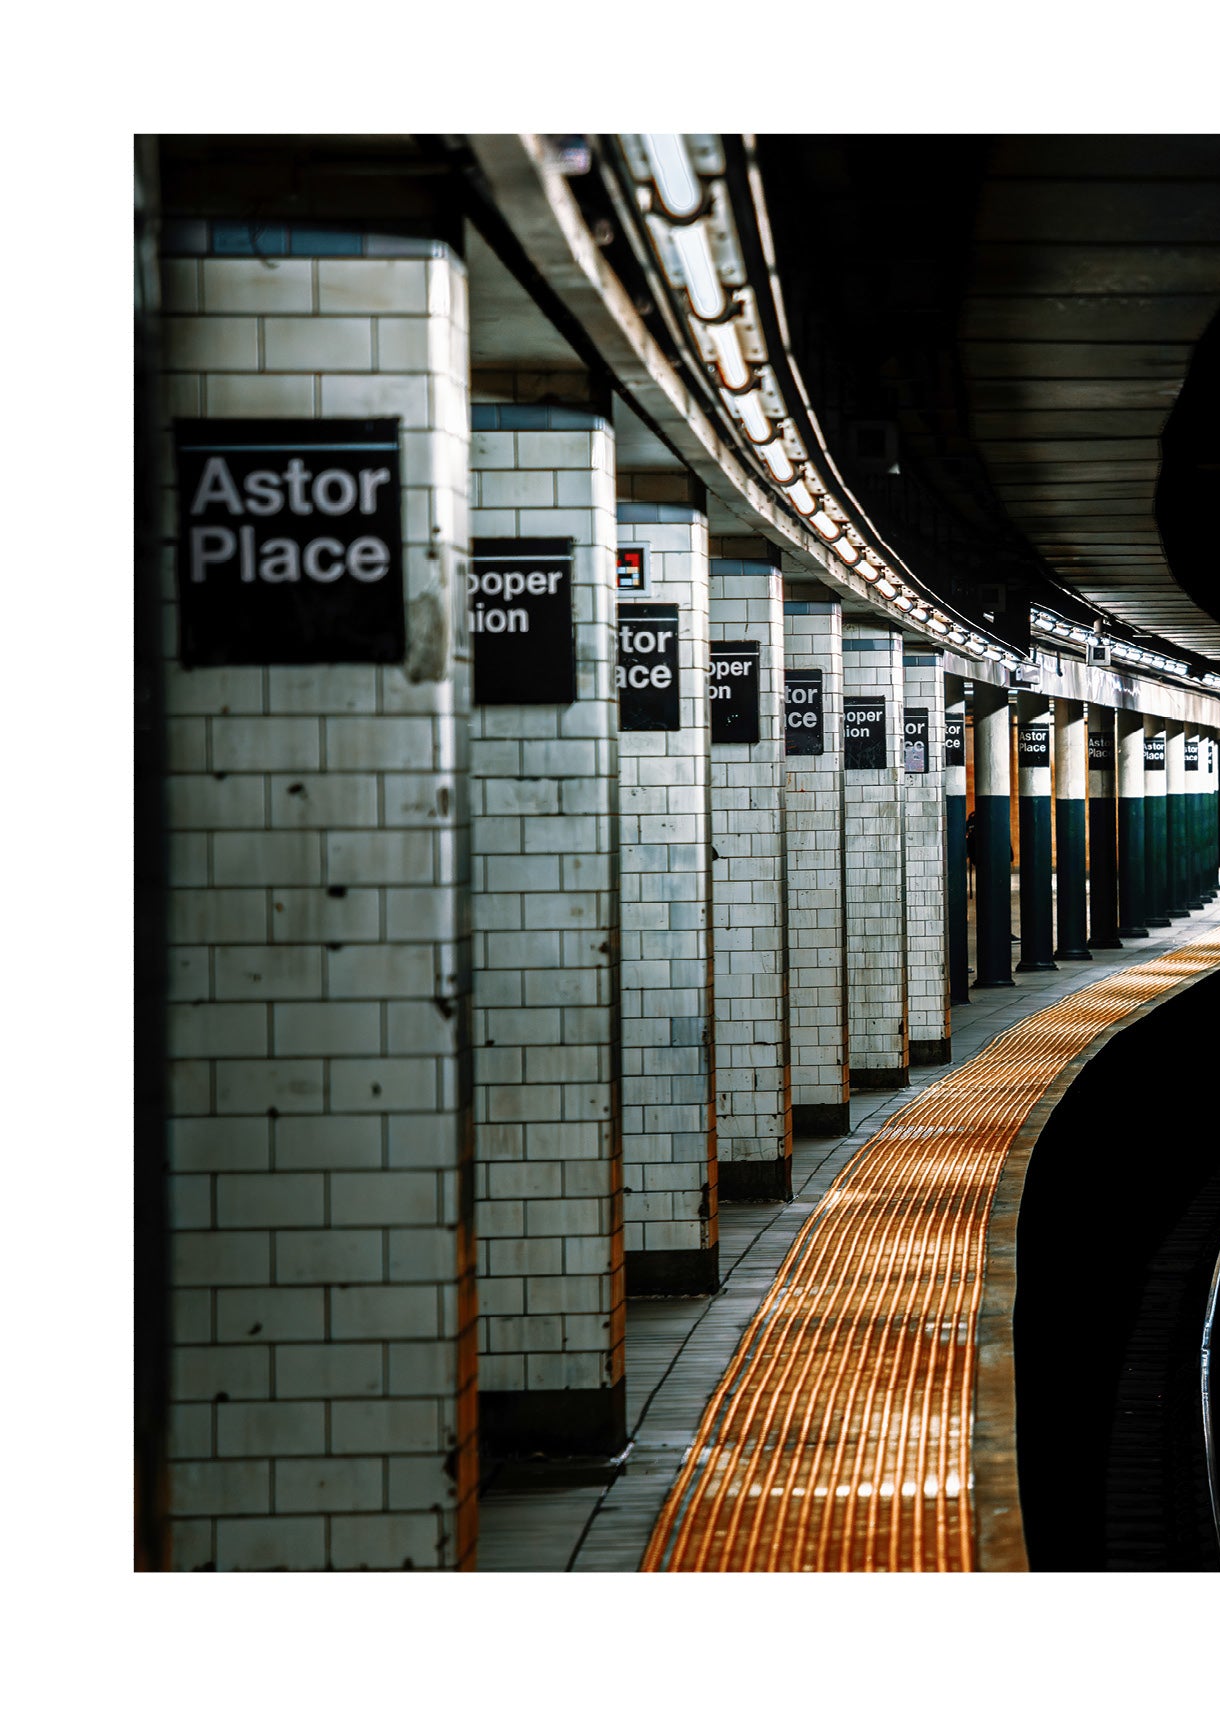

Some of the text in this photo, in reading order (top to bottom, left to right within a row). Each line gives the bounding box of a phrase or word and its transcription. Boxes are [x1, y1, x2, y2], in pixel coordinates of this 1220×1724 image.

[190, 456, 391, 517] Astor
[190, 525, 390, 583] Place
[467, 571, 563, 602] ooper
[468, 602, 529, 633] ion
[617, 626, 673, 653] tor
[615, 665, 672, 689] ace
[709, 661, 752, 680] oper
[784, 686, 818, 704] tor
[845, 711, 883, 725] oper
[845, 725, 870, 738] ion
[1019, 732, 1046, 741] Astor
[1019, 743, 1046, 753] Place
